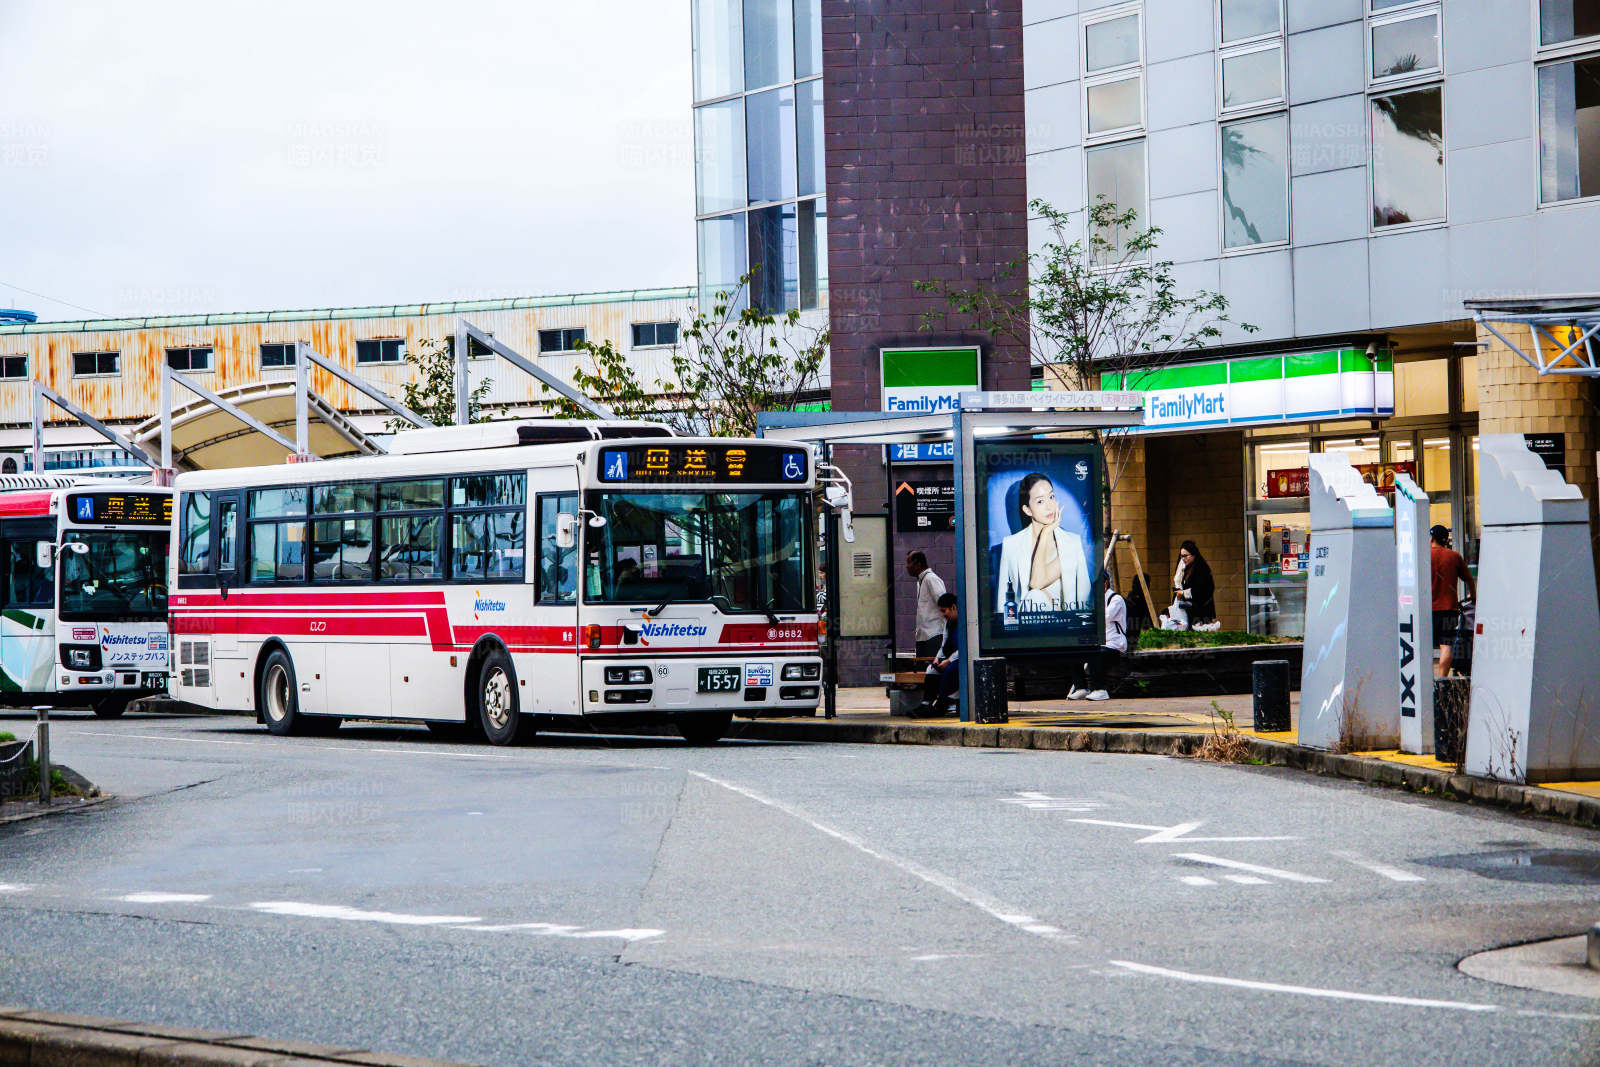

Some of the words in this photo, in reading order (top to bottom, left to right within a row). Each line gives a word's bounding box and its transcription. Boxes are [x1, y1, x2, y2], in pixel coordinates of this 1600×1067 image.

[888, 395, 960, 413] FamilyMa
[1151, 392, 1225, 419] FamilyMart
[647, 449, 707, 469] 回送
[474, 599, 506, 611] Nishitetsu
[1019, 598, 1047, 612] The
[1051, 598, 1091, 612] Focus
[638, 623, 708, 637] Nishitetsu
[778, 630, 803, 638] 9682
[101, 634, 147, 645] Nishitetsu
[109, 652, 166, 661] ノンステップバス
[658, 667, 668, 675] 60
[1399, 613, 1416, 718] TAXI
